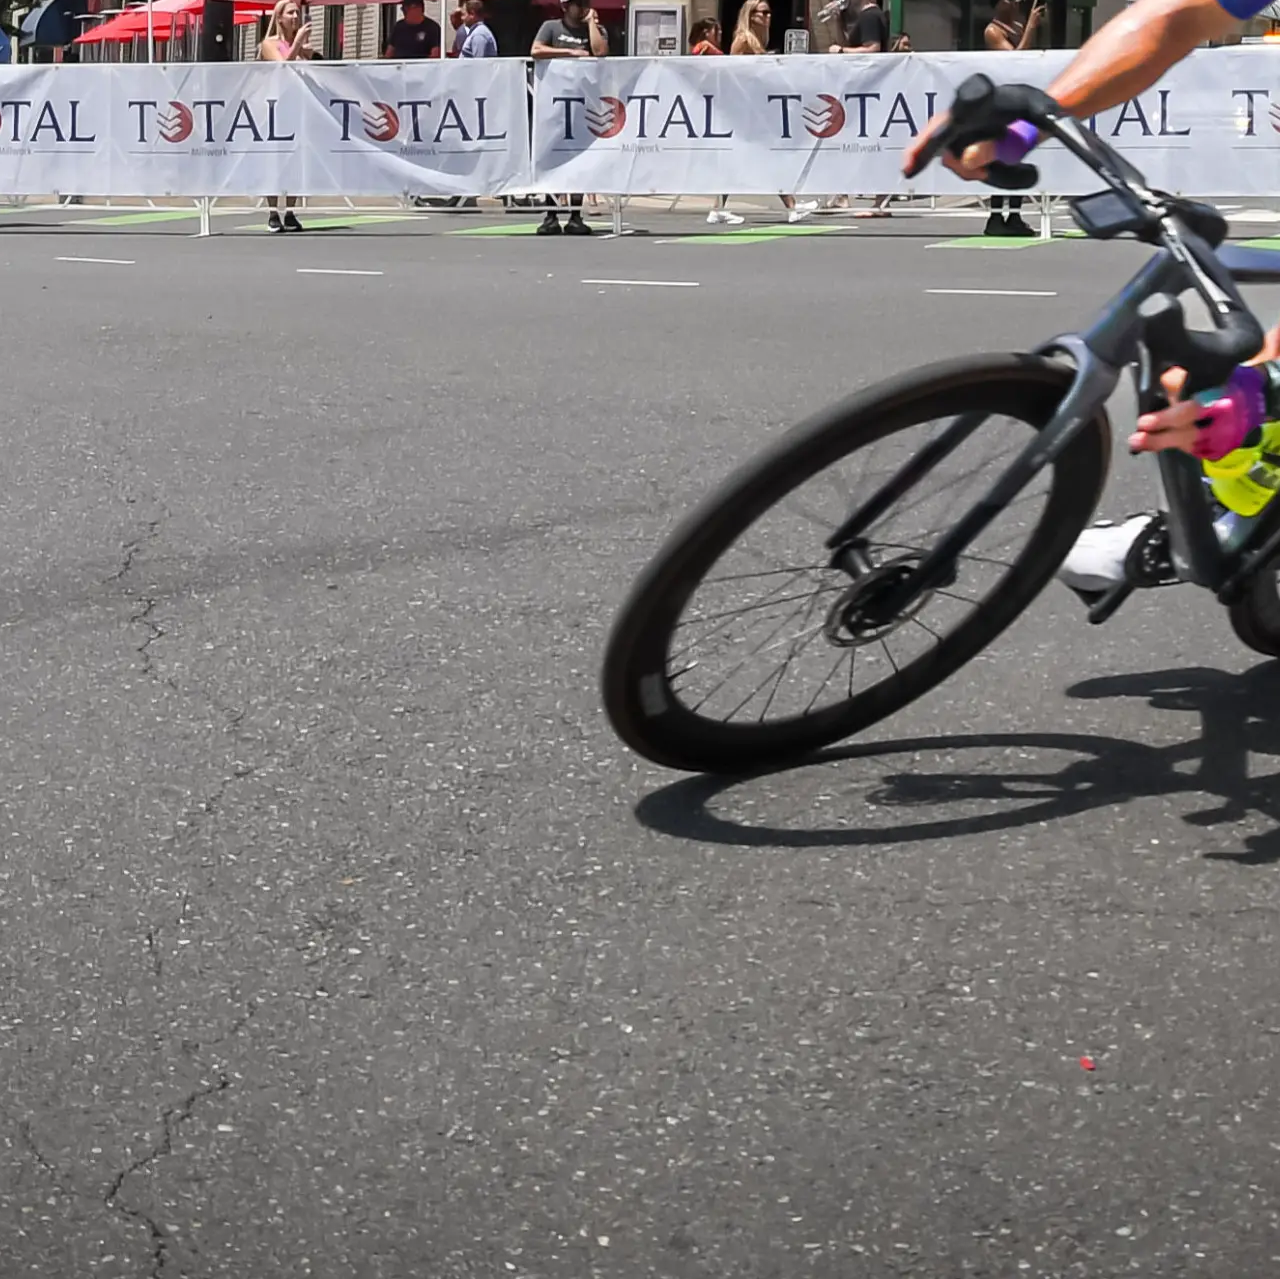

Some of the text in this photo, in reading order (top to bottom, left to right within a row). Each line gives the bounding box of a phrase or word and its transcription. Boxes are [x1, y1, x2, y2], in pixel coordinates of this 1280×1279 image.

[128, 100, 296, 143] TOTAL
[329, 98, 507, 142] TOTAL
[552, 94, 733, 140] TOTAL
[842, 143, 882, 153] Millwork
